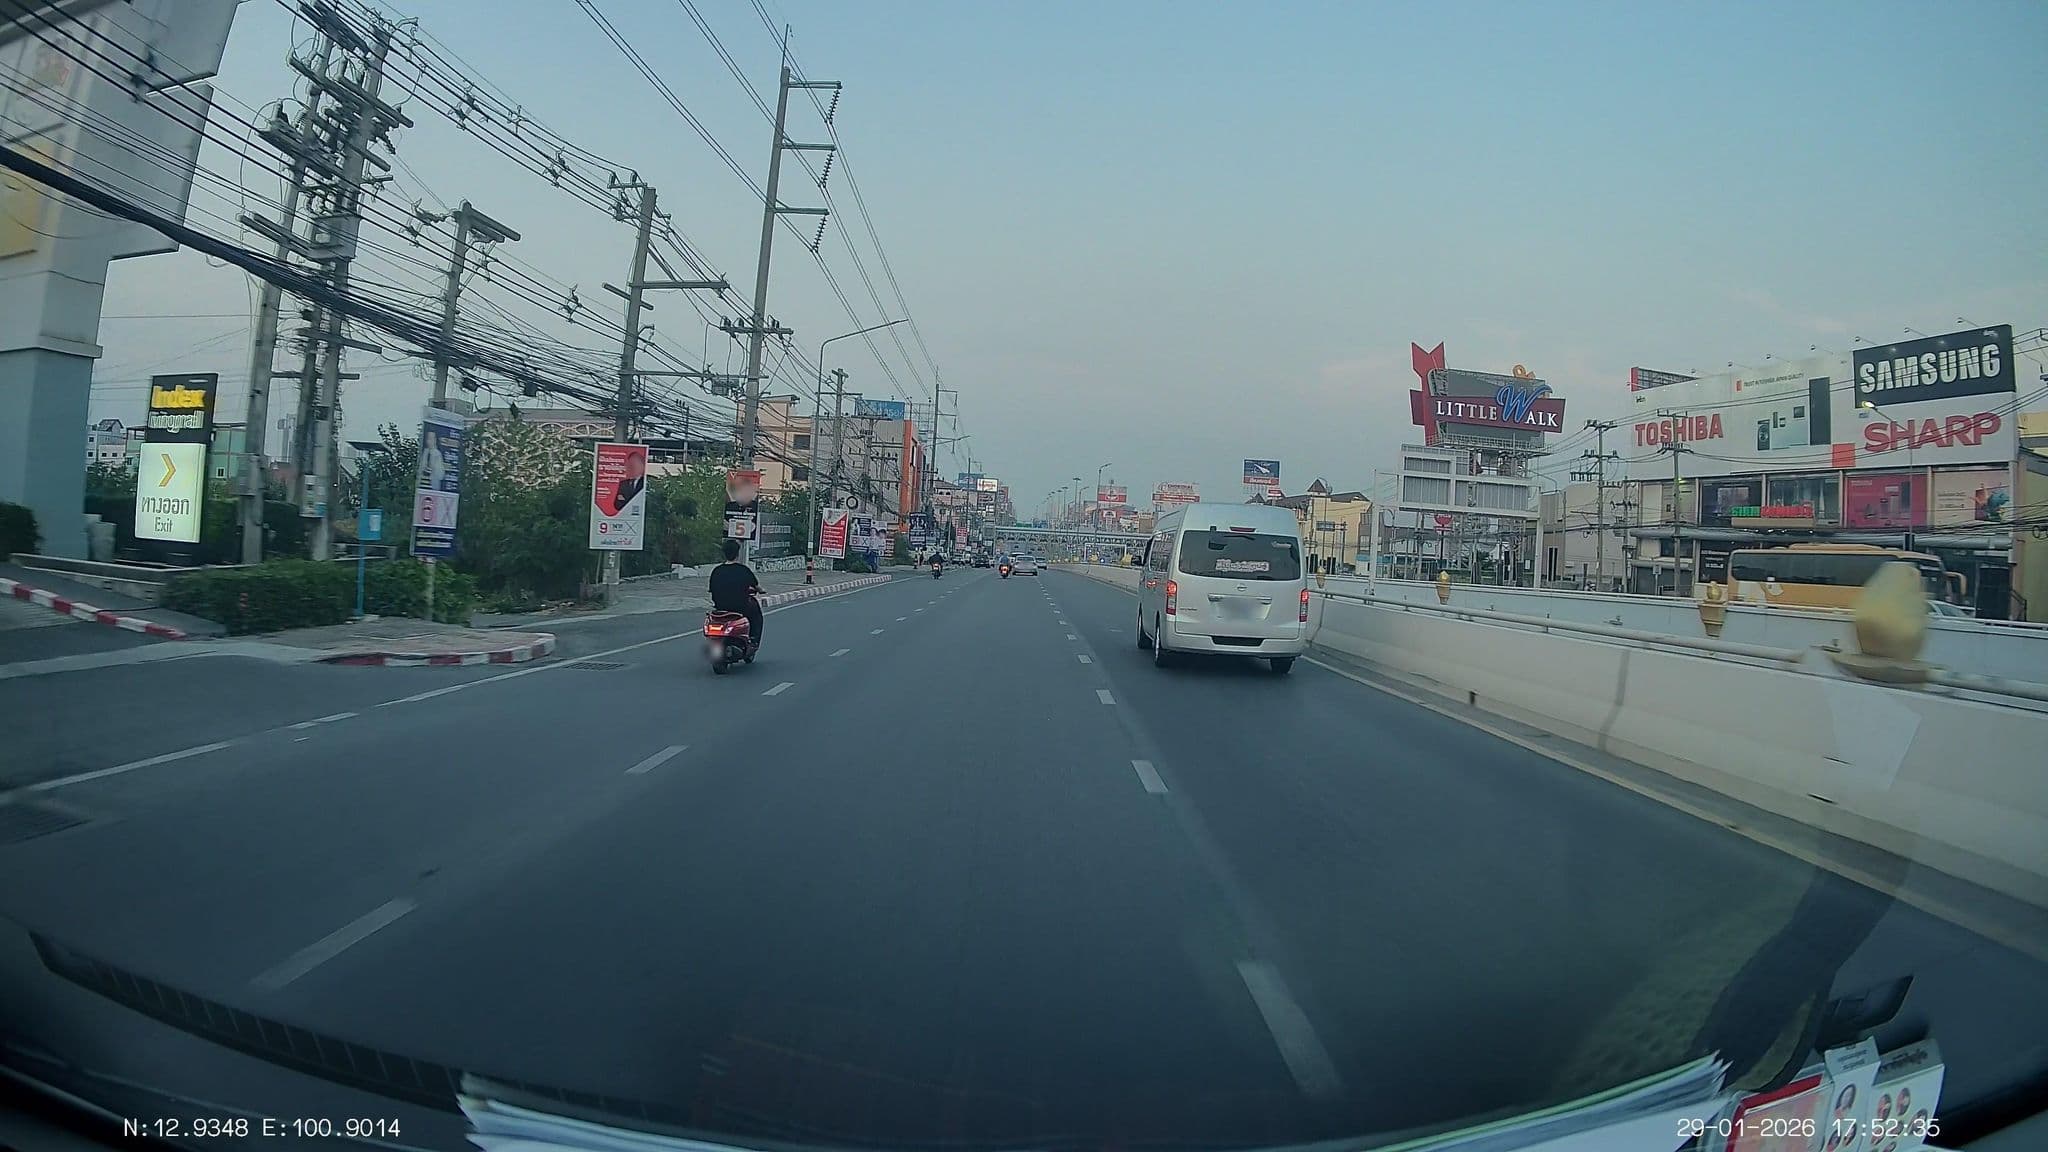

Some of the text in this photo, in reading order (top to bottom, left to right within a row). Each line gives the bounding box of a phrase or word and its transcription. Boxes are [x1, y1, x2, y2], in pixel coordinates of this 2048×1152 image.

[1859, 343, 2001, 394] SAMSUNG
[151, 384, 206, 408] Index
[1436, 401, 1498, 421] LITTLE
[1635, 413, 1723, 447] TOSHIBA
[1864, 412, 2001, 452] SHARP
[141, 496, 190, 515] ทางออก
[154, 516, 173, 533] Exit
[599, 522, 608, 534] 9
